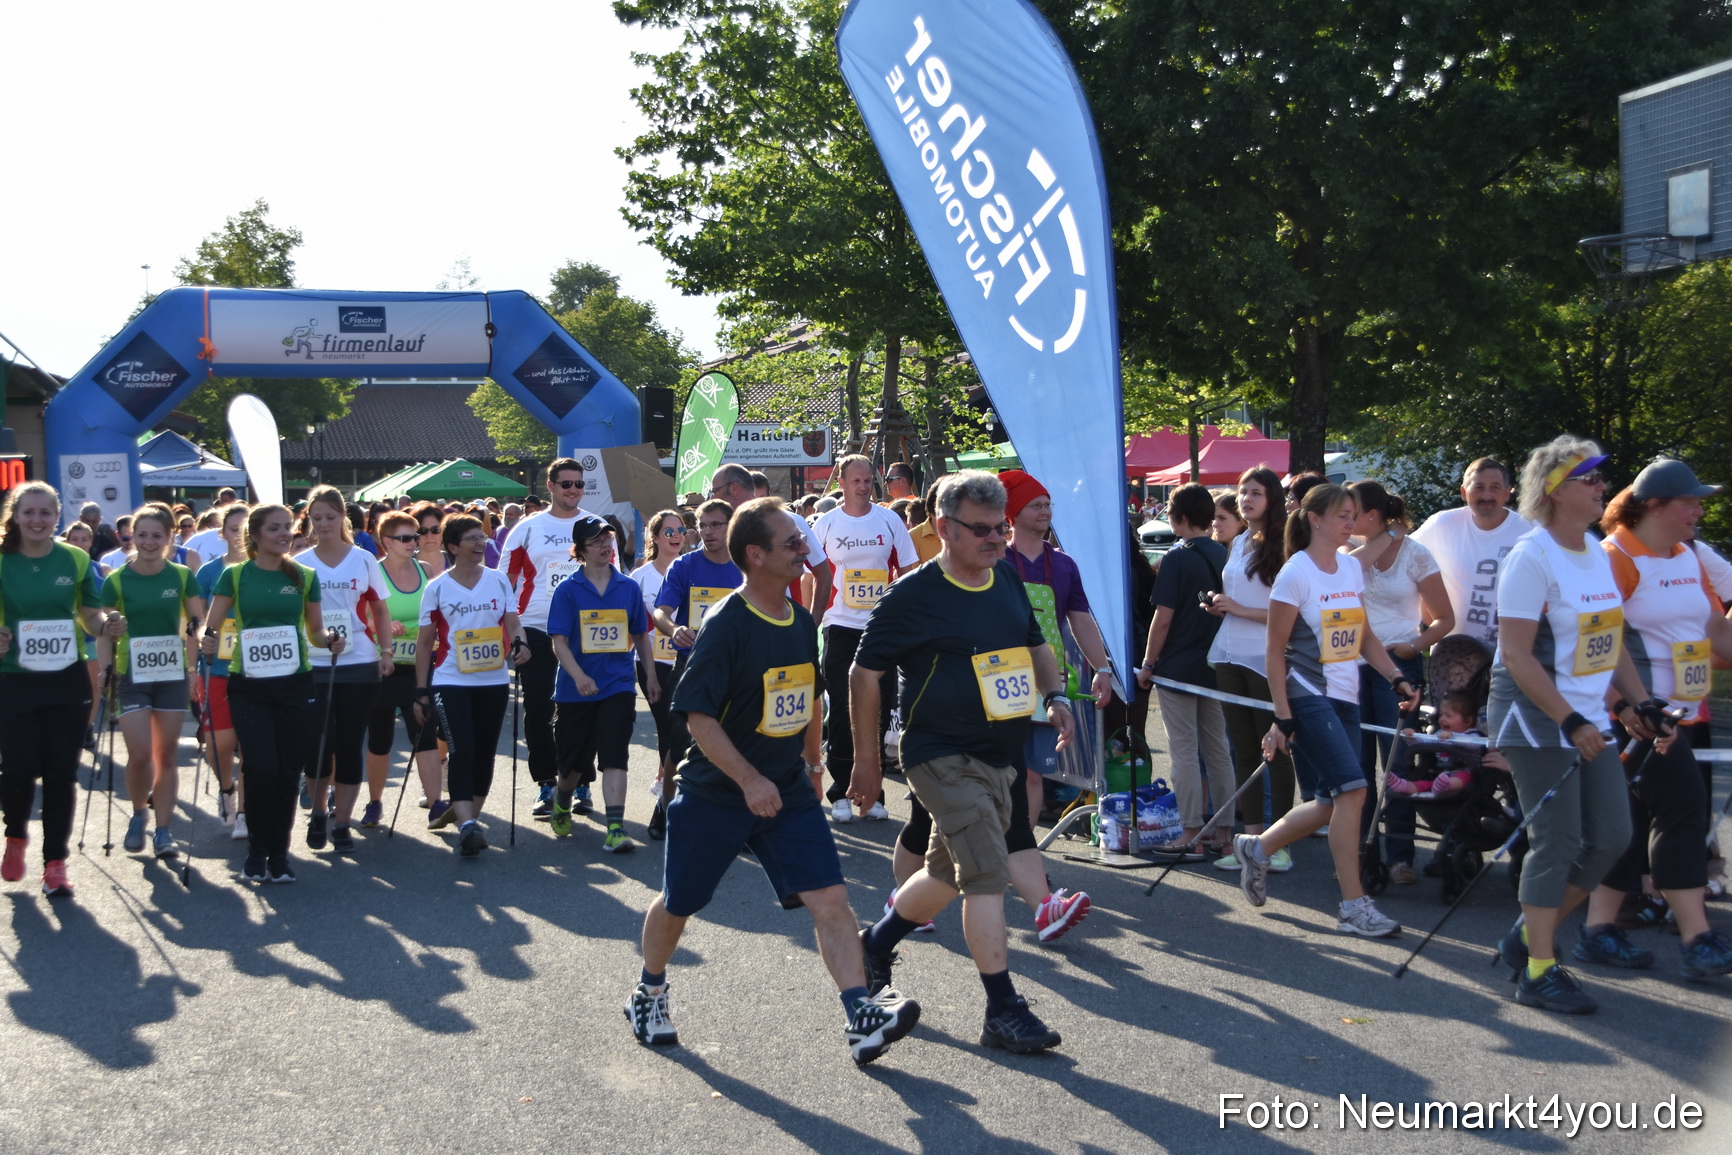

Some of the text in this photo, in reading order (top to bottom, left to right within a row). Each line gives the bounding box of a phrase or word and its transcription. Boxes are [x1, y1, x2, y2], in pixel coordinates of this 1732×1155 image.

[349, 315, 384, 324] Fischer
[323, 334, 426, 352] firmenlauf
[119, 371, 177, 382] Fischer
[705, 418, 729, 450] AOK
[680, 441, 707, 478] AOK
[836, 534, 885, 550] Xplus1
[56, 576, 74, 585] AOK
[163, 588, 178, 597] AOK
[280, 586, 298, 594] AOK
[849, 585, 883, 597] 1514
[448, 599, 498, 616] Xplus1
[22, 623, 69, 633] df-sports
[244, 630, 289, 640] df-sports
[590, 626, 618, 641] 793
[26, 638, 72, 655] 8907
[133, 639, 175, 648] df-sports
[1331, 629, 1355, 648] 604
[1586, 633, 1612, 658] 599
[137, 651, 178, 668] 8904
[250, 643, 293, 663] 8905
[462, 643, 500, 661] 1506
[1684, 664, 1707, 686] 603
[995, 674, 1030, 700] 835
[775, 691, 805, 718] 834
